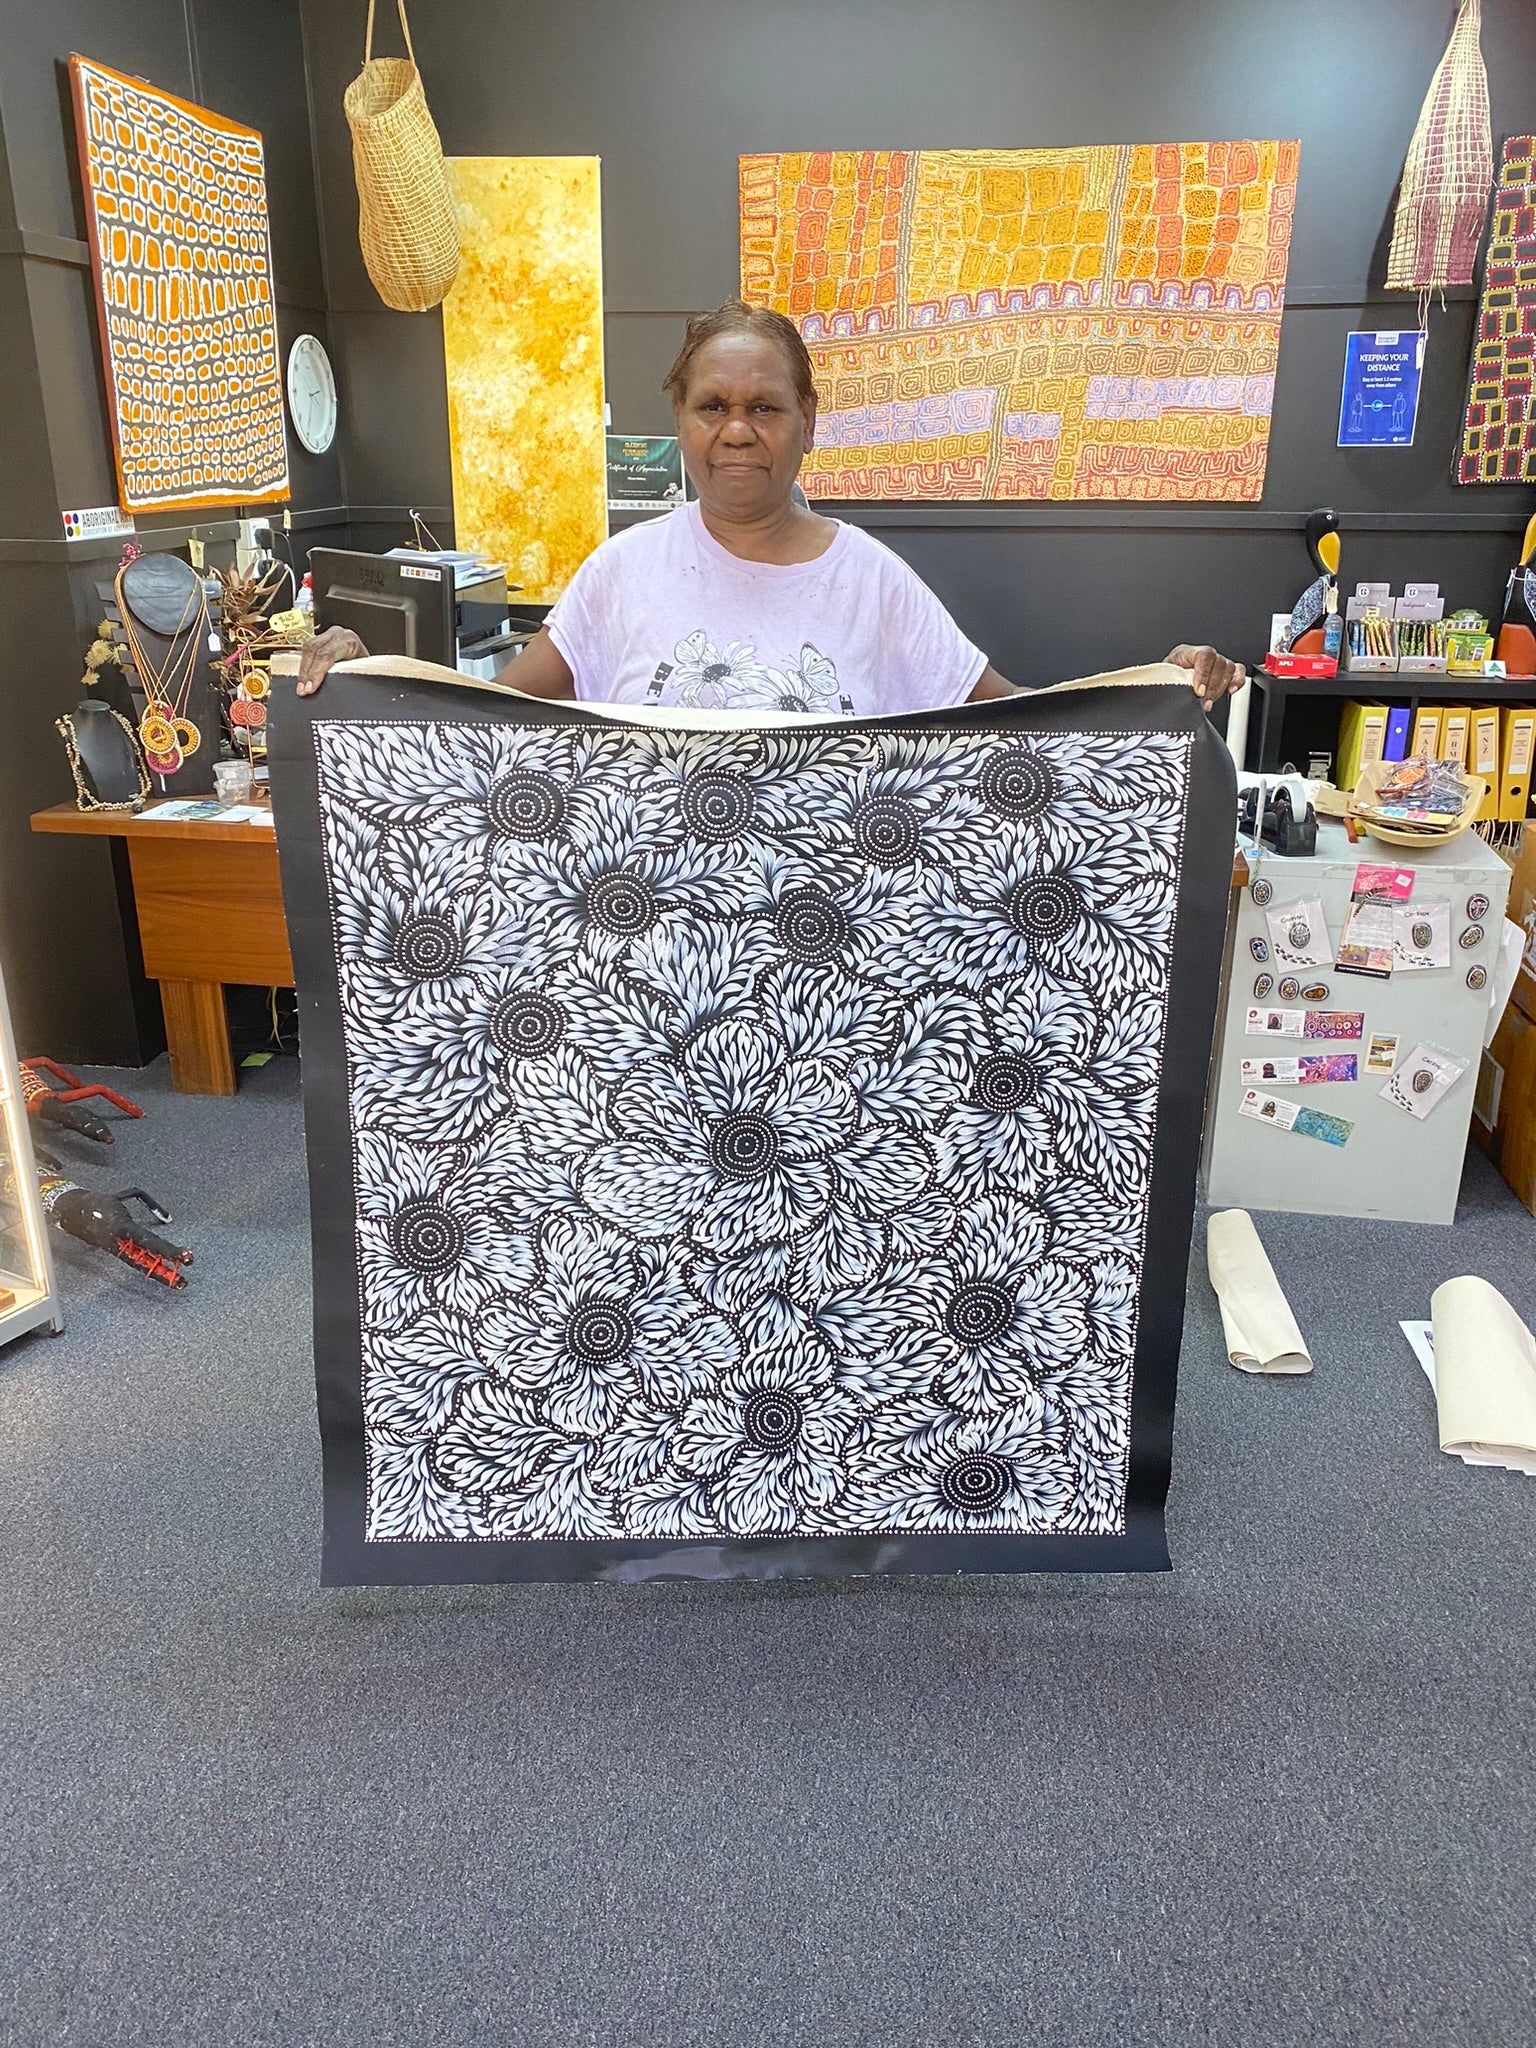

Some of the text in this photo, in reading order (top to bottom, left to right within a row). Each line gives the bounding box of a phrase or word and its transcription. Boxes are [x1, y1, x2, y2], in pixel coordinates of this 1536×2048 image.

[1359, 353, 1409, 362] KEEPING YOUR
[1367, 364, 1401, 372] DISTANCE
[82, 509, 119, 528] ABORIGINAL
